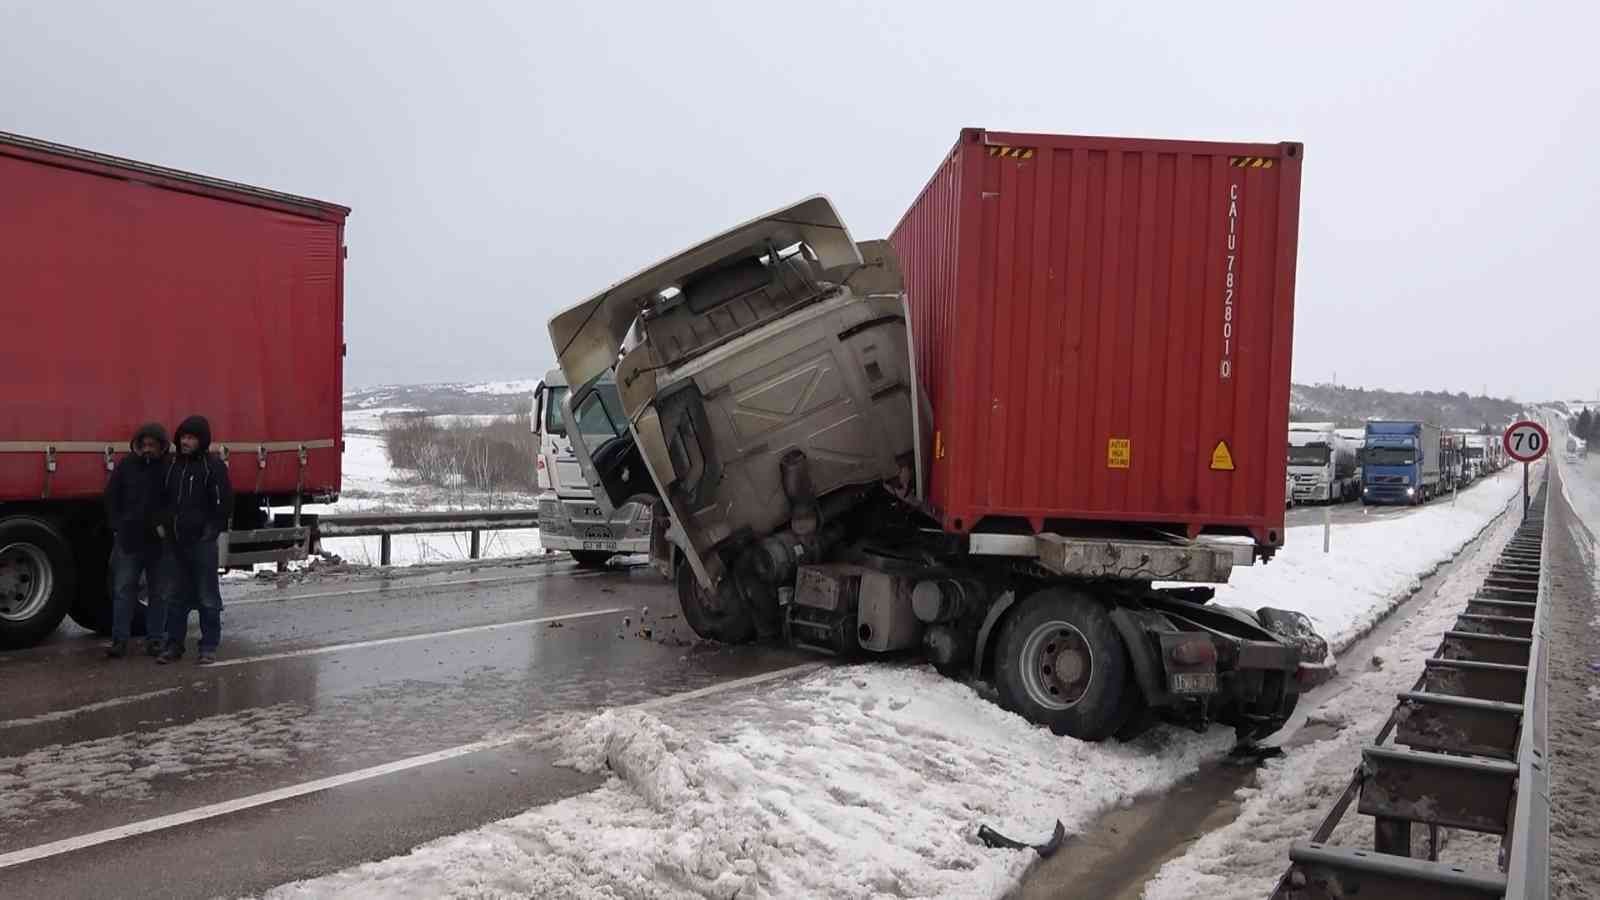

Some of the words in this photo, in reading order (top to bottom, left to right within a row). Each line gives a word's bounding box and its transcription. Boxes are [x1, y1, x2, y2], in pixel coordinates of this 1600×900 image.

[1227, 183, 1238, 250] CAIU
[1223, 255, 1234, 355] 782801
[1512, 432, 1540, 451] 70
